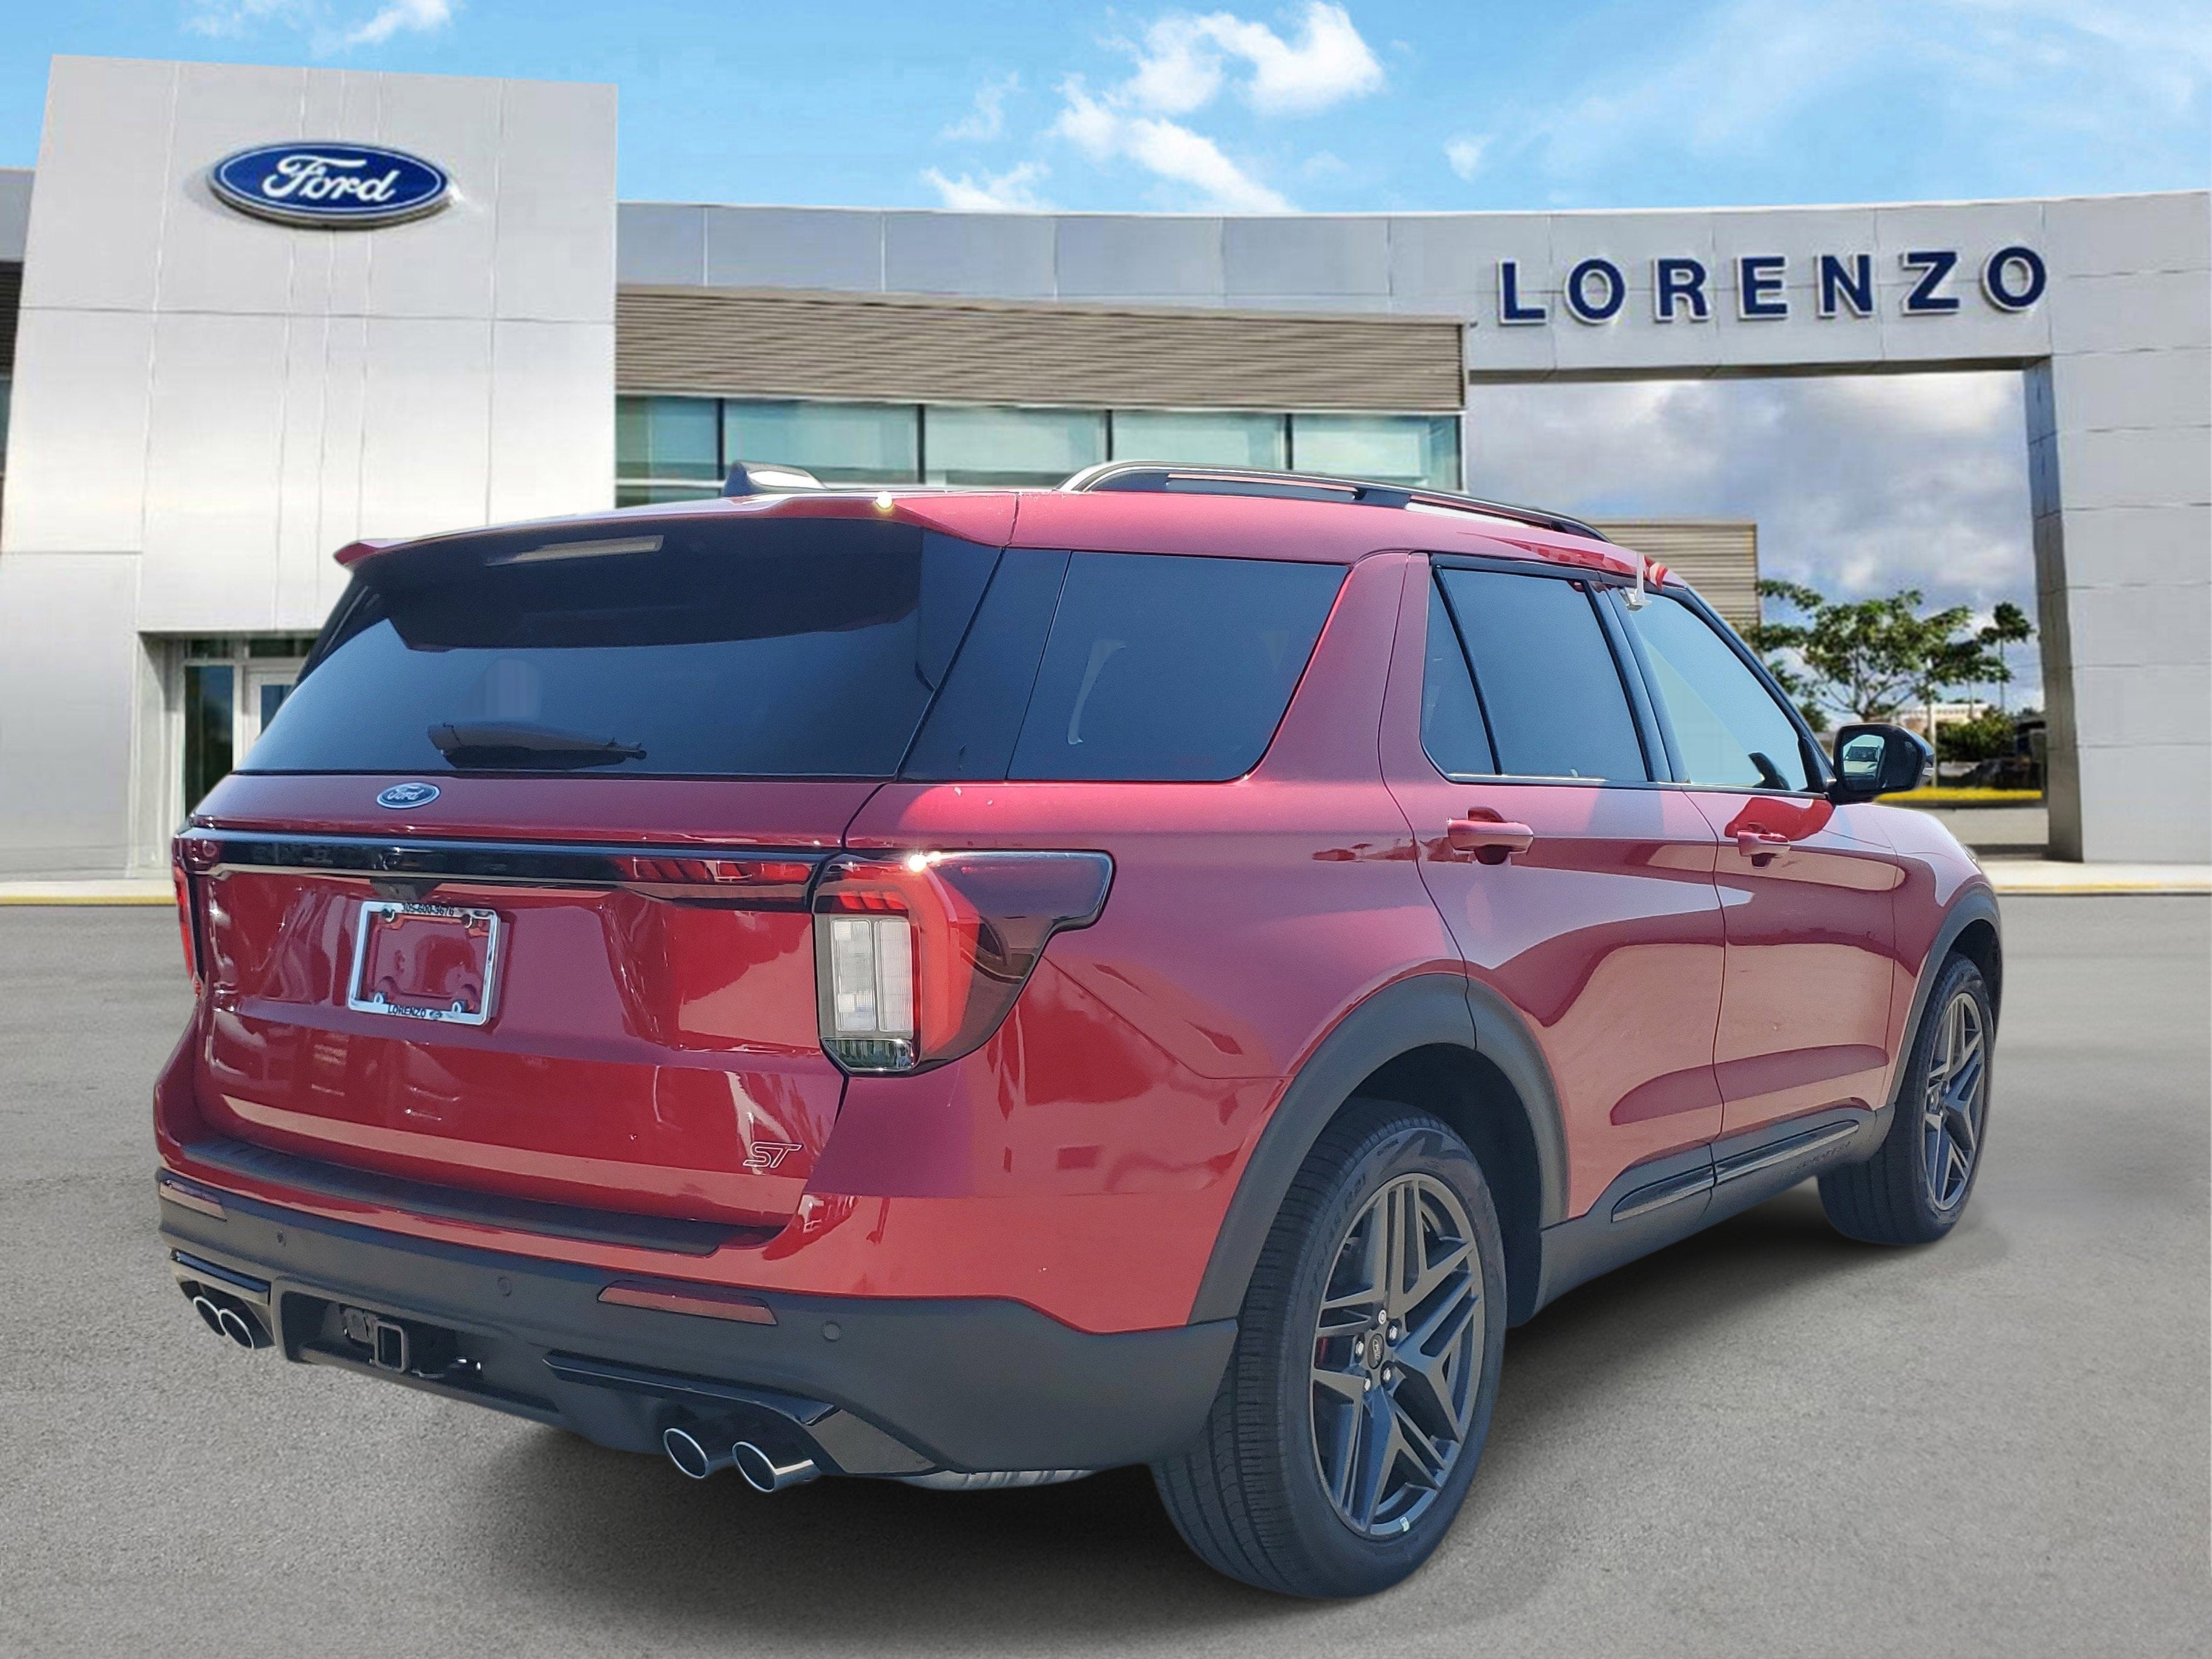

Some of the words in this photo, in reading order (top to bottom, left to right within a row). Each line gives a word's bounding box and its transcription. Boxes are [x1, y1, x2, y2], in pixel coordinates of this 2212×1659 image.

[262, 154, 401, 202] Ford
[1496, 246, 2047, 324] LORENZO
[387, 1004, 427, 1018] LORENZO
[742, 1141, 802, 1168] ST
